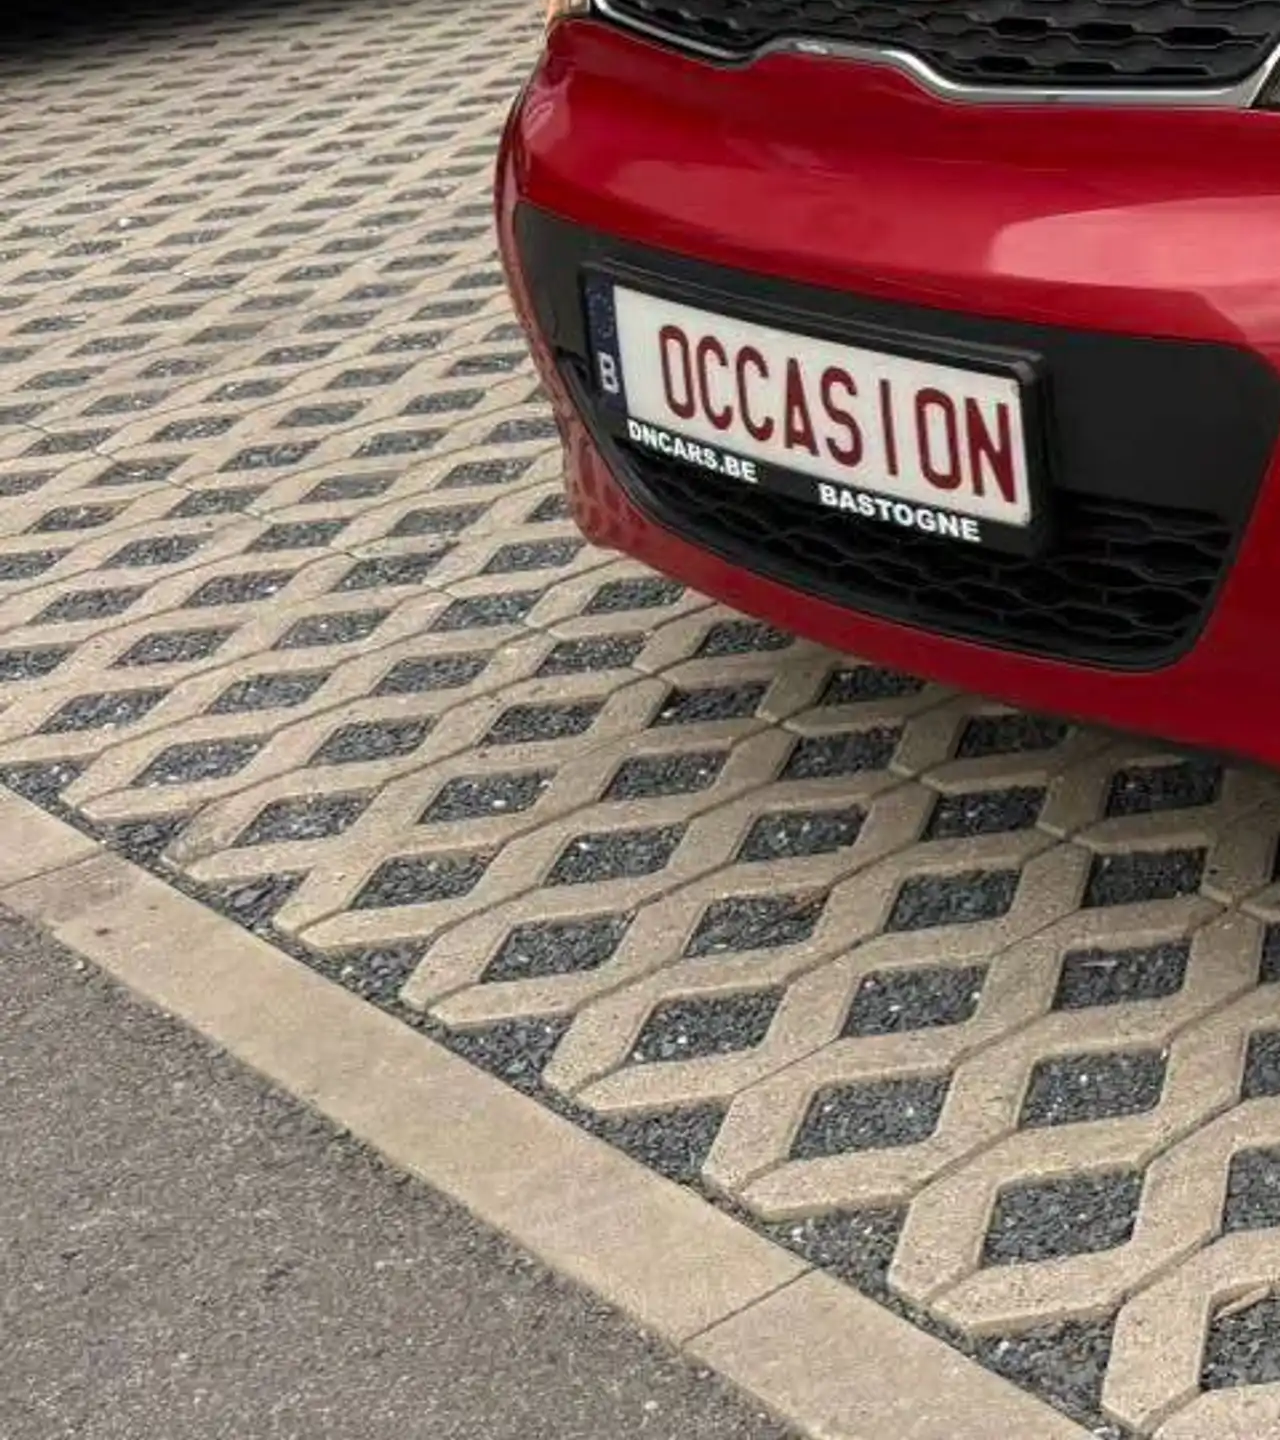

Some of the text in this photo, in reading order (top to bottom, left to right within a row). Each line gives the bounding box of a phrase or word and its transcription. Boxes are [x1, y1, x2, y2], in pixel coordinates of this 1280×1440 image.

[659, 324, 1017, 504] OCCASION
[627, 419, 759, 484] DNCARS.BE
[819, 484, 982, 542] BASTOGNE
